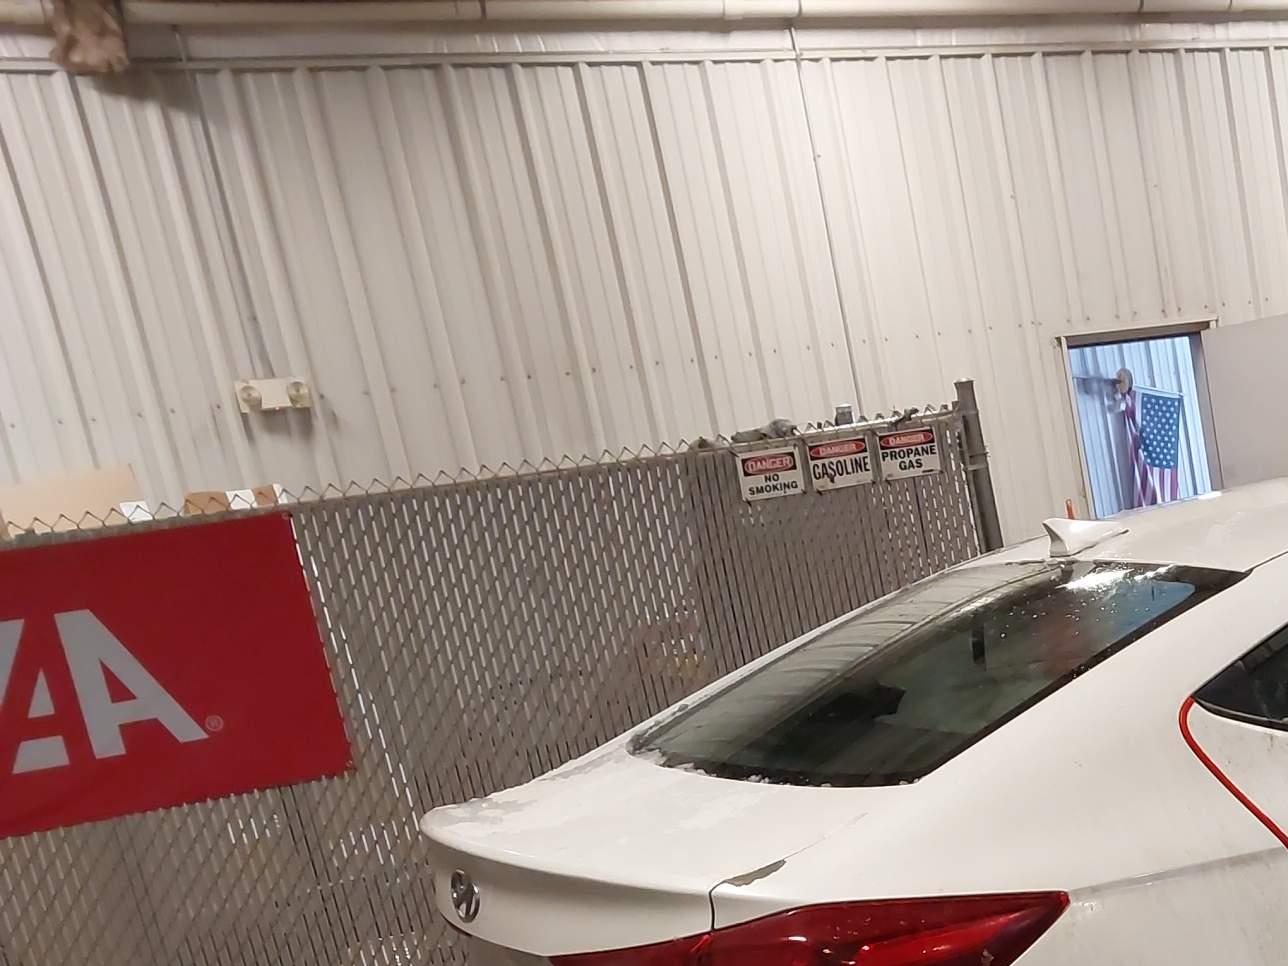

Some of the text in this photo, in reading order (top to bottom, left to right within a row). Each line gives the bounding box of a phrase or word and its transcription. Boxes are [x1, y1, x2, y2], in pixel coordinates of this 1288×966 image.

[881, 445, 937, 462] PROPANE
[747, 455, 792, 472] DANGER
[812, 456, 871, 481] GASOLINE
[898, 458, 923, 471] GAS
[764, 473, 780, 483] NO
[748, 480, 798, 496] SMOKING
